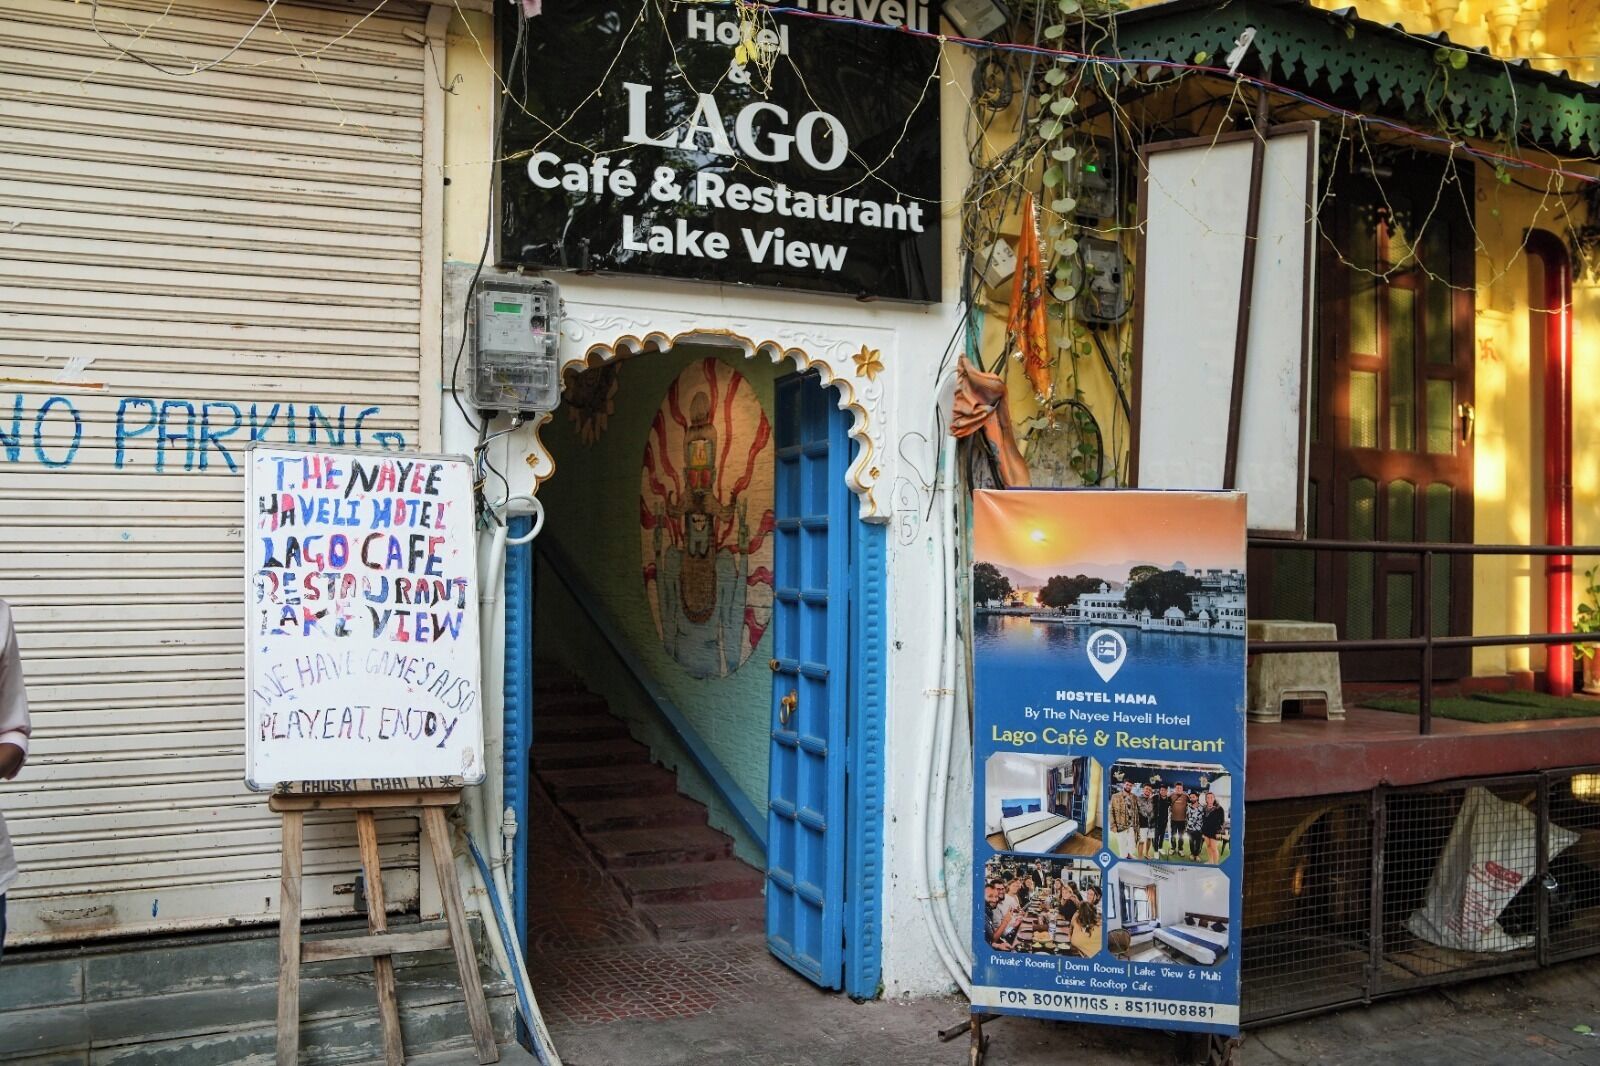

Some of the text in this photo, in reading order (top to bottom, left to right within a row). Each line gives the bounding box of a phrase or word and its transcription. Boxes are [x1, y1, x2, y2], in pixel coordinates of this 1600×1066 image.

[622, 81, 850, 171] LAGO
[527, 151, 925, 233] Café & Restaurant
[622, 214, 848, 272] Lake View
[114, 397, 406, 472] PARKING
[344, 457, 443, 499] NAYEE
[258, 493, 447, 532] HAVELI HOTEL
[261, 532, 446, 577] LAGO CAFE
[253, 569, 469, 609] RESTAURANT
[259, 600, 464, 643] LAKE VIEW
[252, 662, 294, 705] WE
[296, 650, 355, 688] HAVE
[1056, 690, 1158, 705] HOSTEL MAMA
[379, 707, 458, 748] ENJOY
[1024, 706, 1190, 726] By The Nayee Haveli Hotel
[992, 725, 1226, 753] Lago Café & Restaurant
[990, 954, 1222, 981] Private Rooms Dorm Rooms Lake View & Multi
[1055, 975, 1086, 987] Cuisine
[1090, 978, 1128, 992] Rooftop
[999, 990, 1028, 1006] FOR
[1033, 993, 1109, 1011] BOOKINGS
[1125, 1000, 1215, 1018] 8511408881
